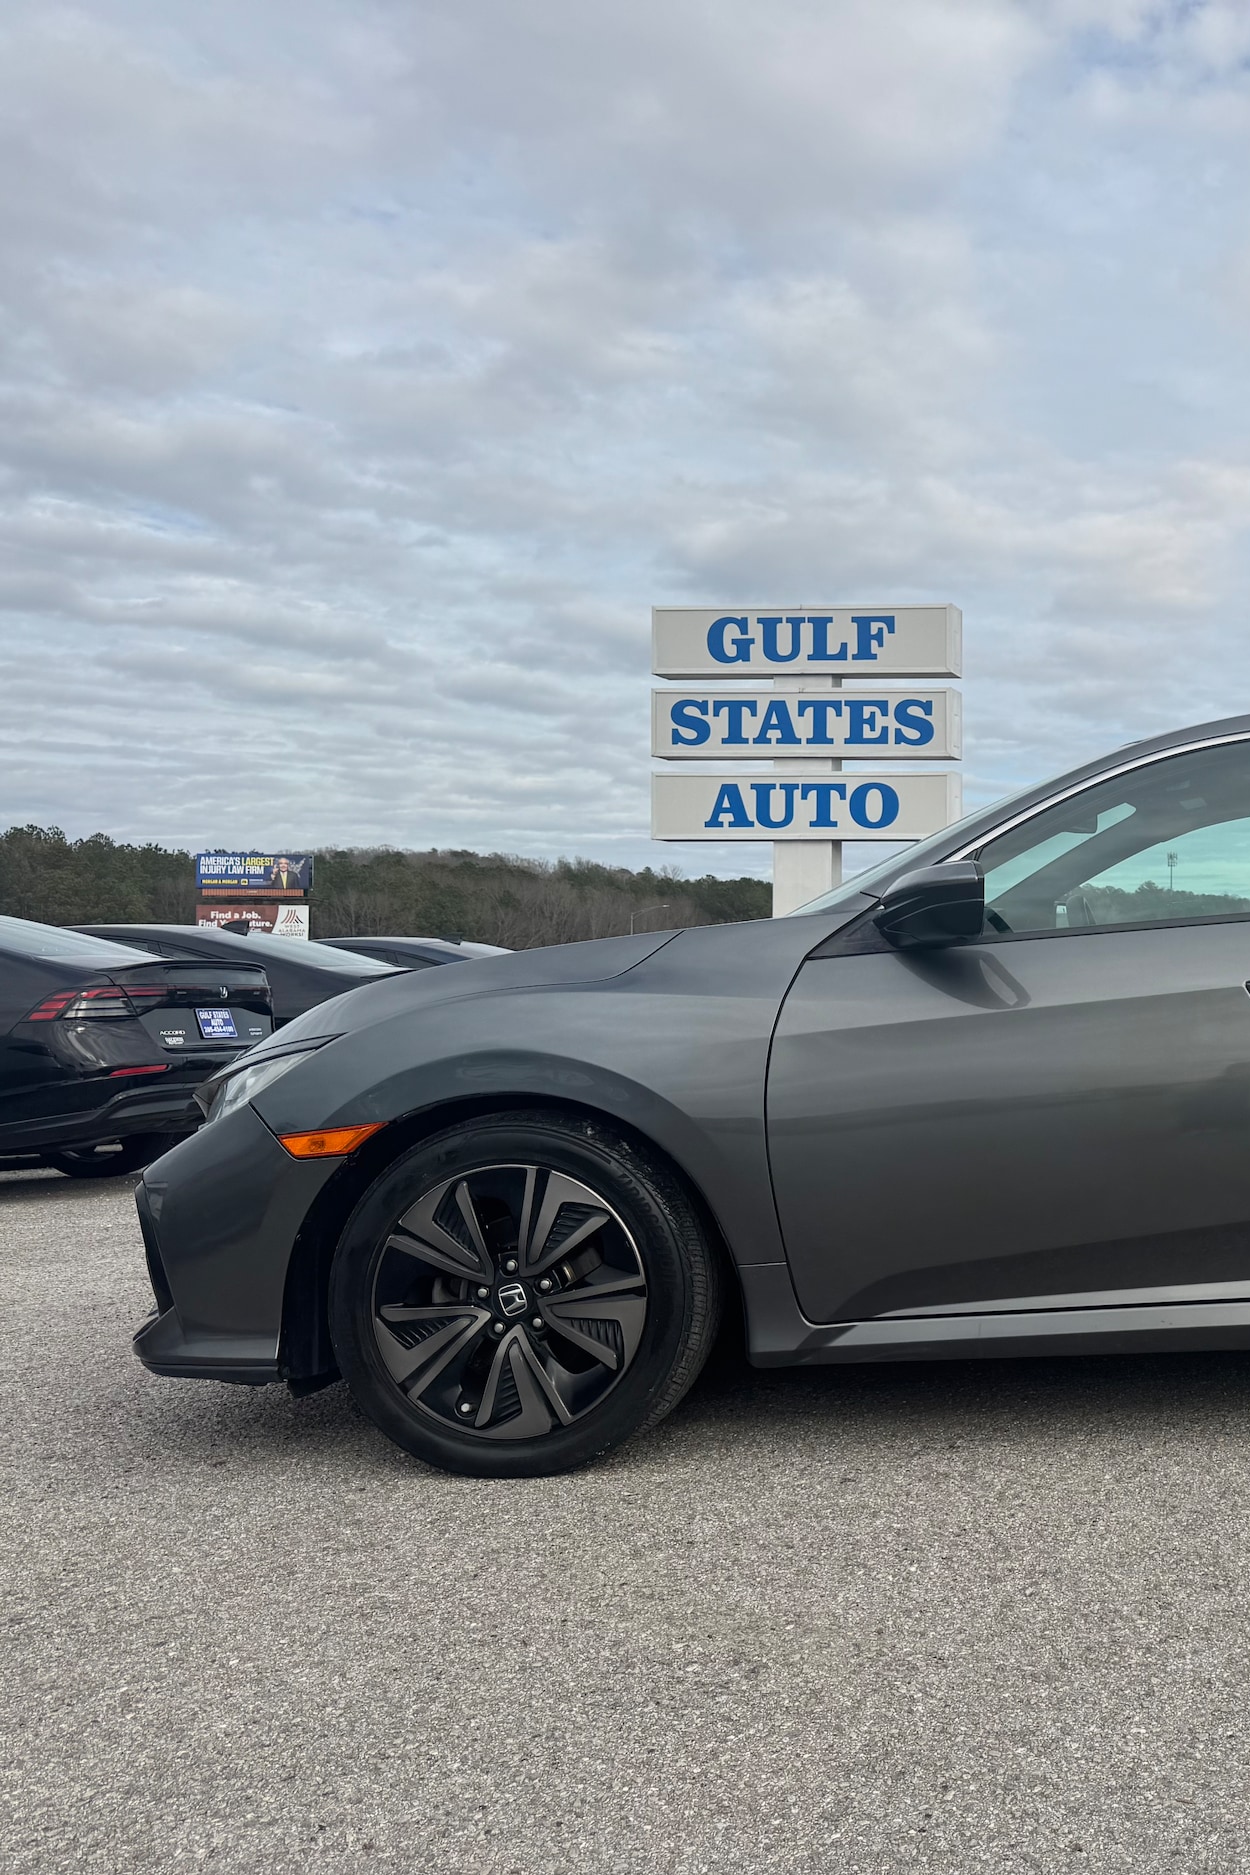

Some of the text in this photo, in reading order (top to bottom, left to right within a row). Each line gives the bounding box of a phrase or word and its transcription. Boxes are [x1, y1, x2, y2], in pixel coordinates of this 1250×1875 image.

[706, 615, 896, 663] GULF
[670, 698, 935, 746] STATES
[704, 782, 900, 829] AUTO
[200, 856, 274, 866] AMERICA'S LARGEST
[200, 865, 264, 874] INJURY LAW FIRM
[210, 911, 231, 919] Find
[241, 911, 261, 919] Job.
[198, 919, 218, 927] Find
[249, 919, 273, 927] ture.
[199, 1011, 229, 1019] GULF STATES
[211, 1018, 224, 1026] AUTO
